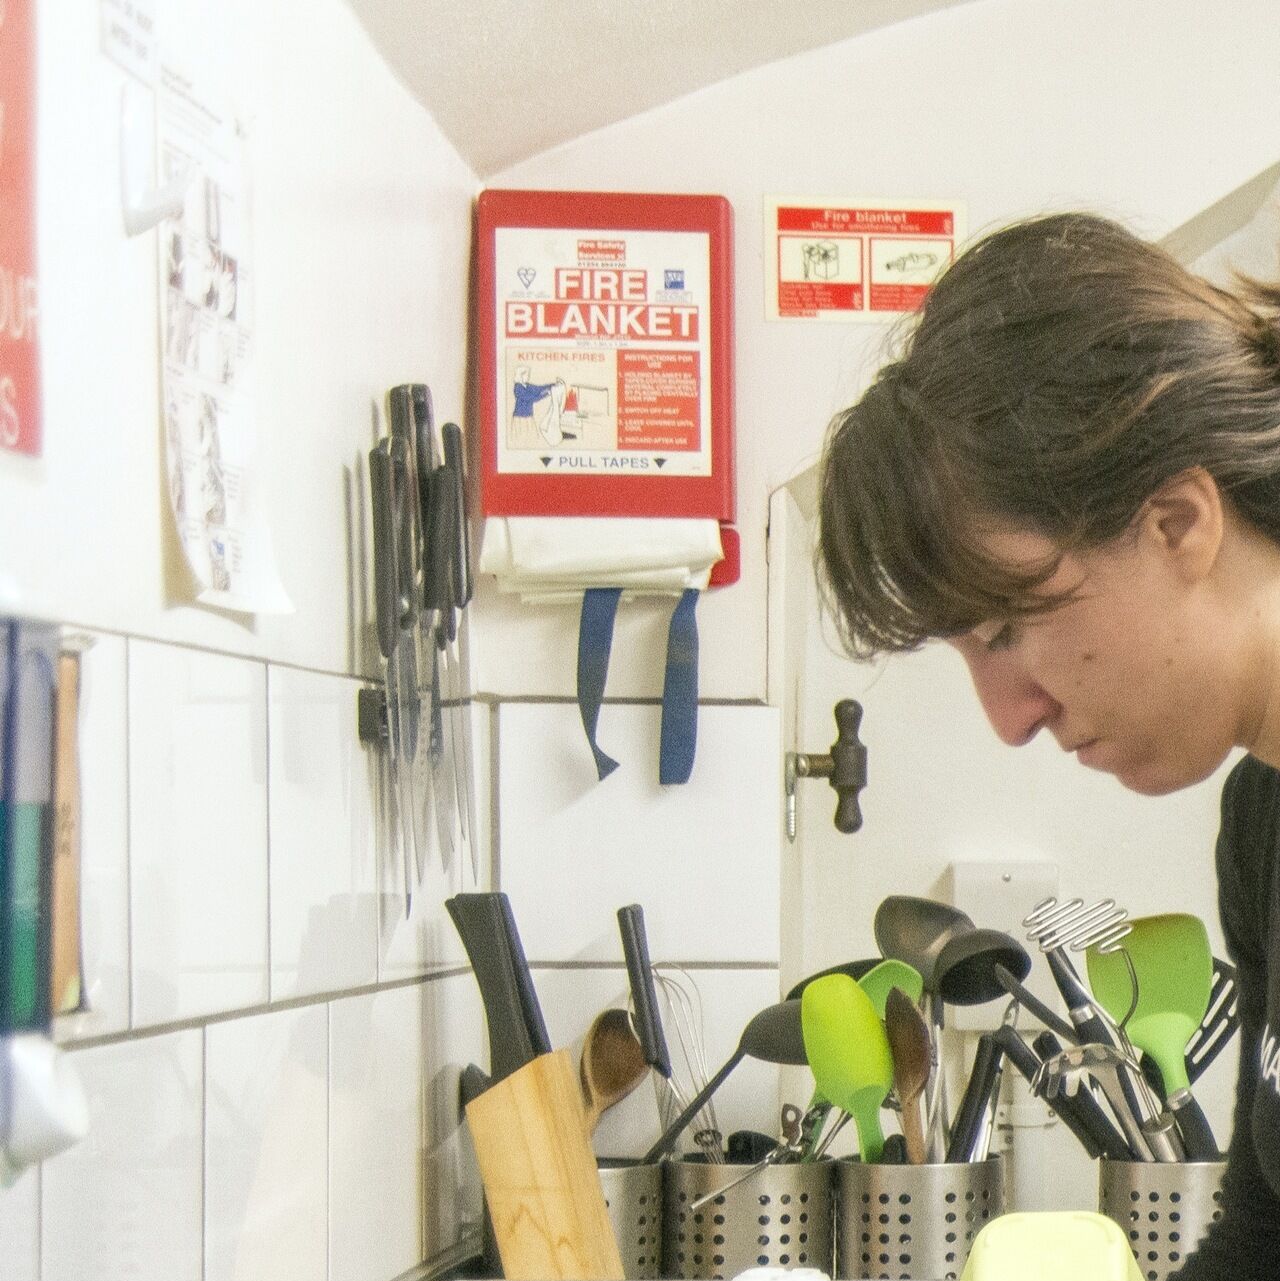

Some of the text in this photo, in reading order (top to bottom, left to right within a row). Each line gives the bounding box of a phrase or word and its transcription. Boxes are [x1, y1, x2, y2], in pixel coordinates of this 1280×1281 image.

[823, 210, 907, 223] Fire blanket
[558, 270, 647, 300] FIRE
[507, 303, 698, 336] BLANKET
[518, 352, 606, 361] KITCHEN FIRES
[559, 456, 650, 469] PULL TAPES
